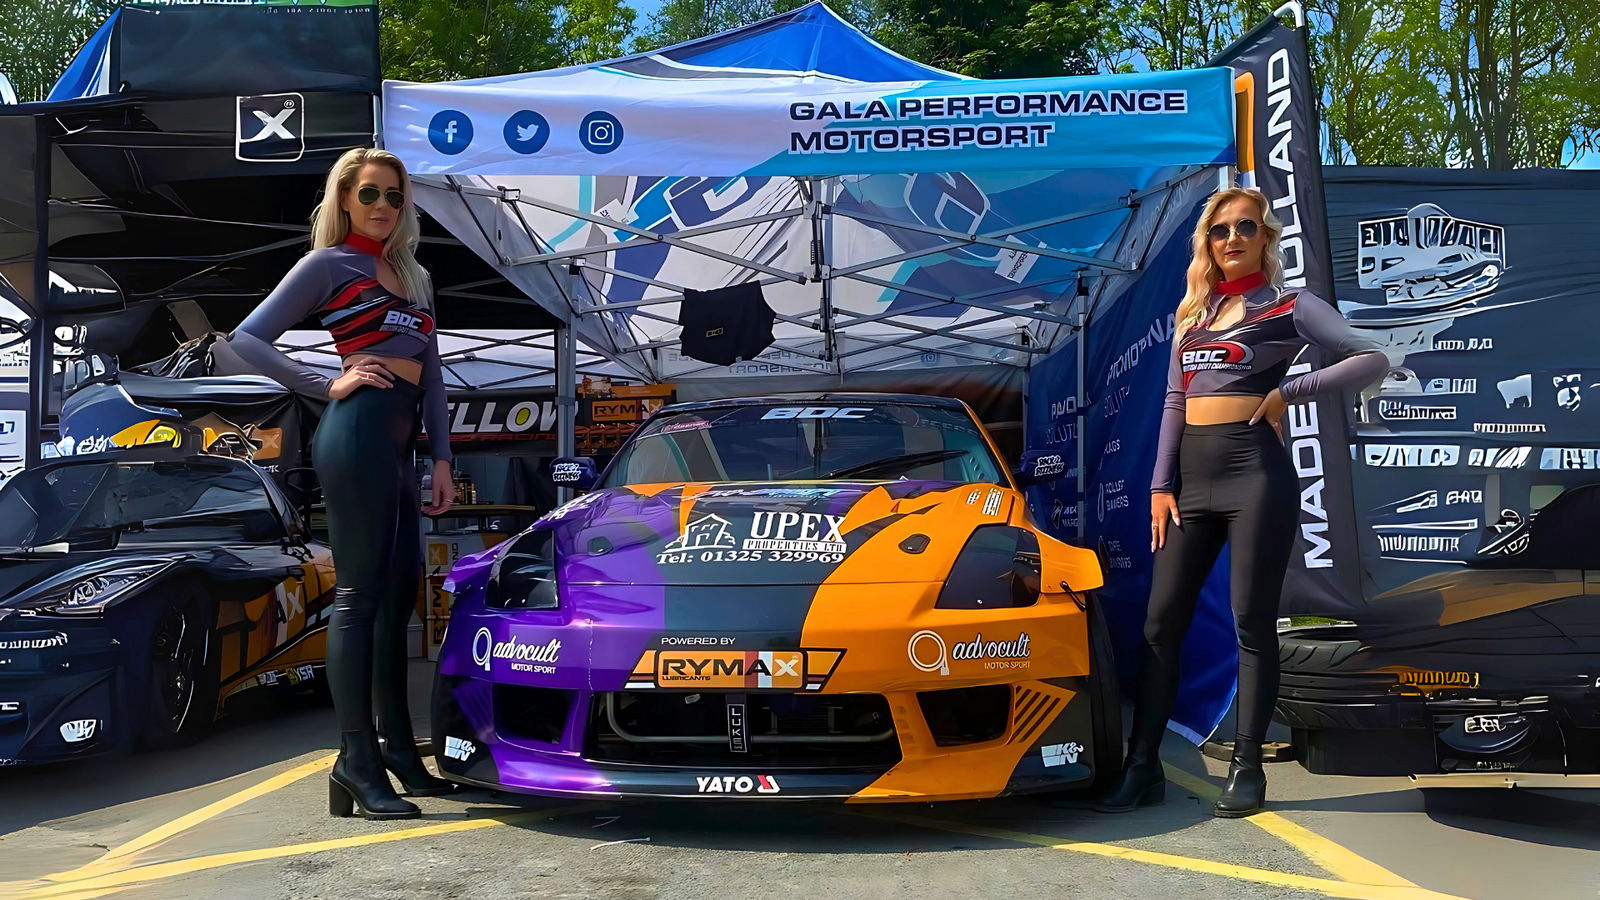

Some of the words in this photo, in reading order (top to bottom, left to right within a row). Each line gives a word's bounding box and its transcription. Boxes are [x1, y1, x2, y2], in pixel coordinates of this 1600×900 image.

[790, 99, 891, 121] GALA
[900, 91, 1186, 119] PERFORMANCE
[790, 124, 1053, 152] MOTORSPORT
[383, 310, 423, 330] BDC
[1182, 349, 1227, 365] BDC
[760, 407, 874, 420] BDC
[1288, 401, 1334, 568] MADE
[750, 511, 847, 544] UPEX
[747, 540, 819, 551] PROPERTIES
[656, 552, 694, 565] Tel:
[700, 551, 762, 562] 01325
[767, 551, 845, 564] 329969
[493, 635, 562, 663] advocult
[661, 637, 718, 645] POWERED
[720, 637, 736, 645] BY
[952, 632, 1031, 660] advocult
[511, 662, 534, 672] MOTOR
[533, 666, 557, 674] SPORT
[662, 658, 799, 677] RYMAX
[984, 662, 1010, 670] MOTOR
[1010, 661, 1031, 669] SPORT
[696, 776, 754, 793] YATO
